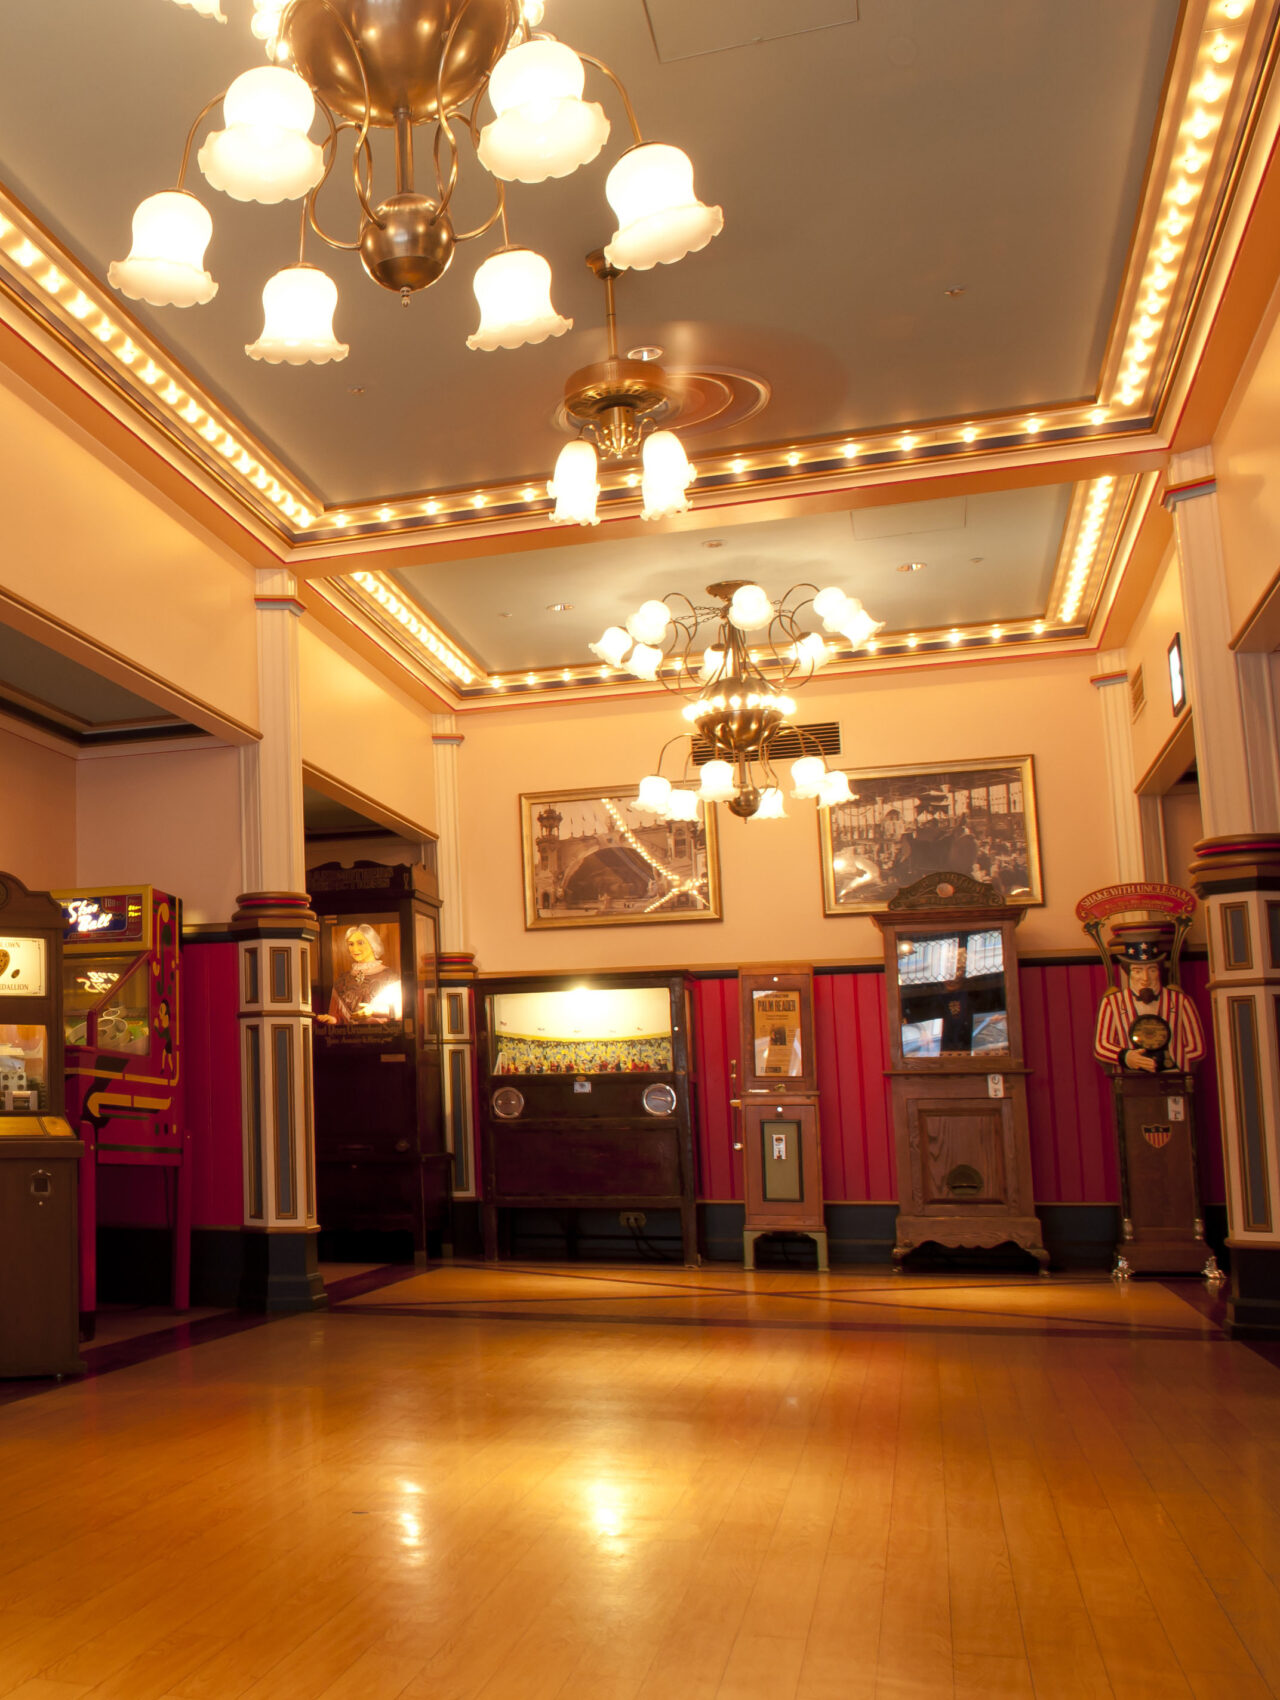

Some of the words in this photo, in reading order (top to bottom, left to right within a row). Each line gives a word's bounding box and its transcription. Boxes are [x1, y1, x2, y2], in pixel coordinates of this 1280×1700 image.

[1081, 890, 1109, 906] SHAKE
[1109, 885, 1135, 896] WITH
[1137, 884, 1168, 894] UNCLE
[1169, 887, 1191, 901] SAM
[77, 913, 113, 932] Ball
[758, 999, 774, 1012] PALM
[775, 999, 796, 1012] READER
